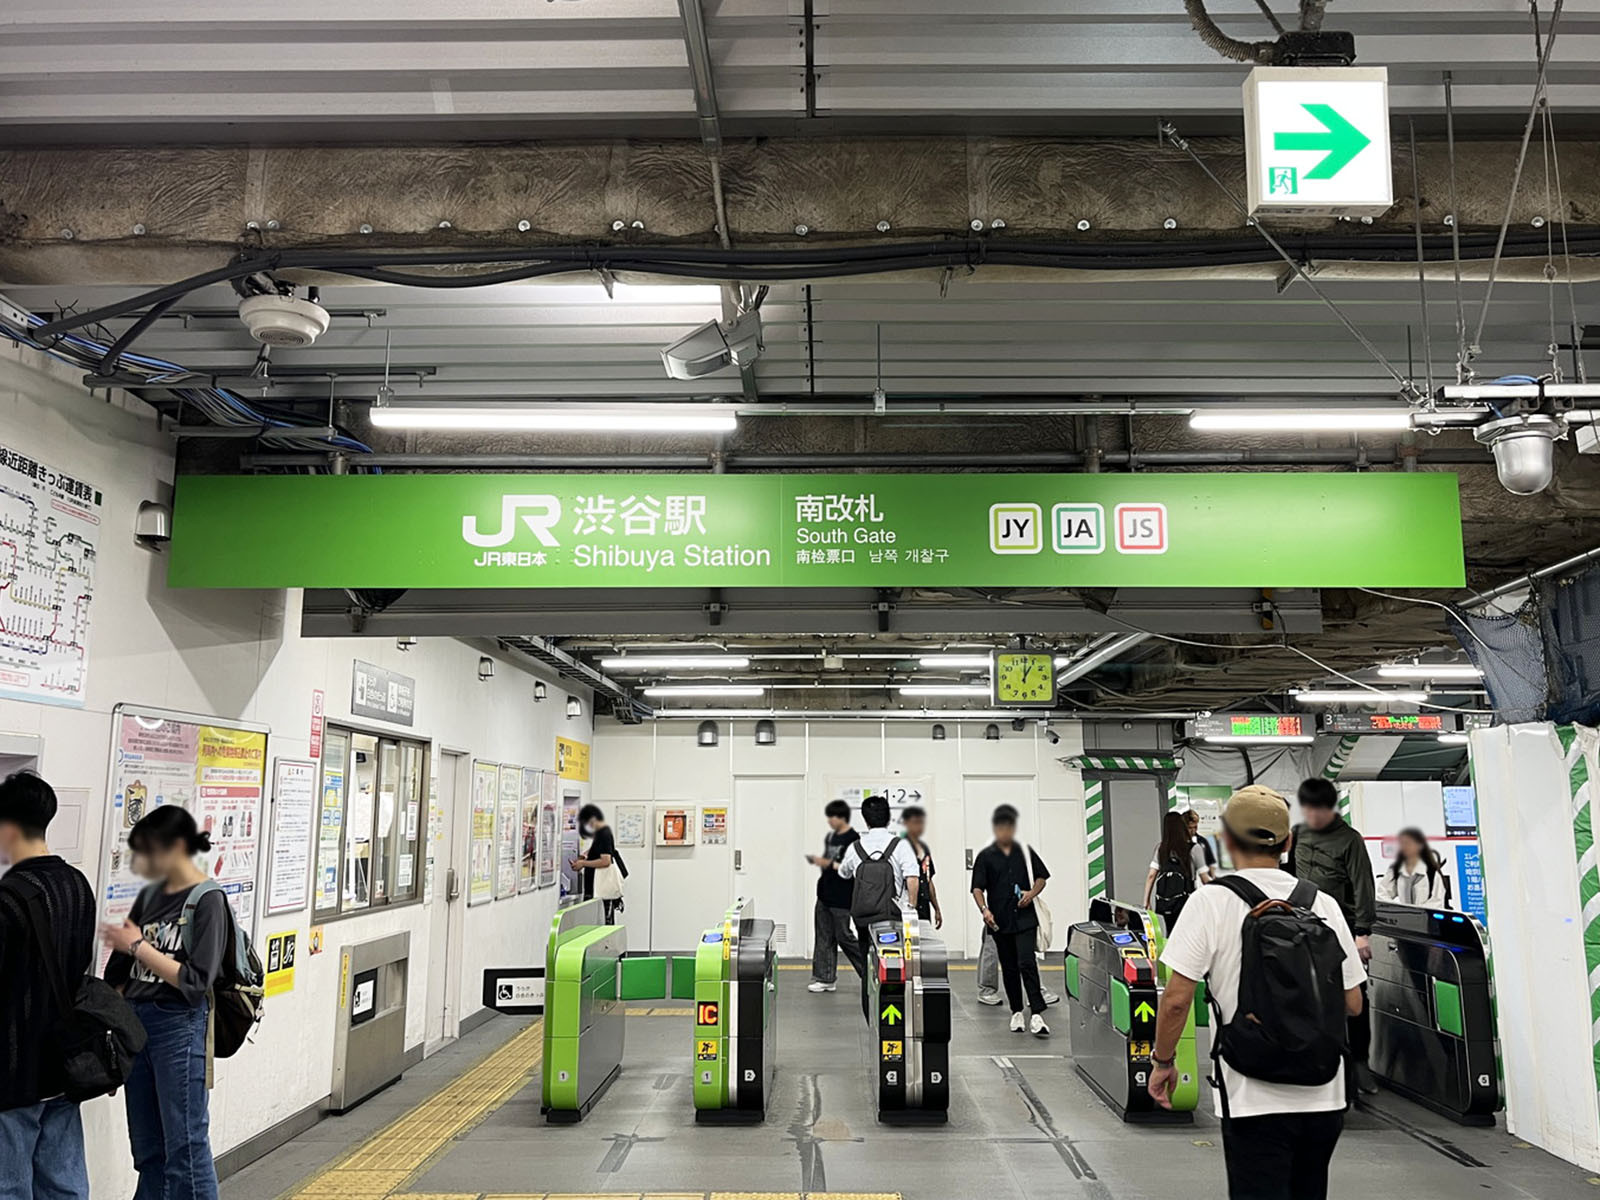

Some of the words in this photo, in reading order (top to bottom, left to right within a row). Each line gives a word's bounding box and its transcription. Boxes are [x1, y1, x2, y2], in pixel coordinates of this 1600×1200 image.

[572, 494, 707, 536] 渋谷駅
[795, 493, 884, 523] 南改札
[462, 494, 562, 547] JR
[1002, 518, 1030, 539] JY
[1063, 518, 1094, 539] JA
[1128, 518, 1154, 539] JS
[796, 528, 848, 544] South
[853, 528, 897, 544] Gate
[474, 551, 547, 567] JR東日本
[574, 544, 675, 572] Shibuya
[684, 544, 770, 567] Station
[795, 549, 856, 565] 南检票口
[868, 549, 898, 565] 남쪽
[905, 549, 950, 565] 개찰구
[1325, 714, 1333, 725] 3
[698, 1004, 719, 1024] IC
